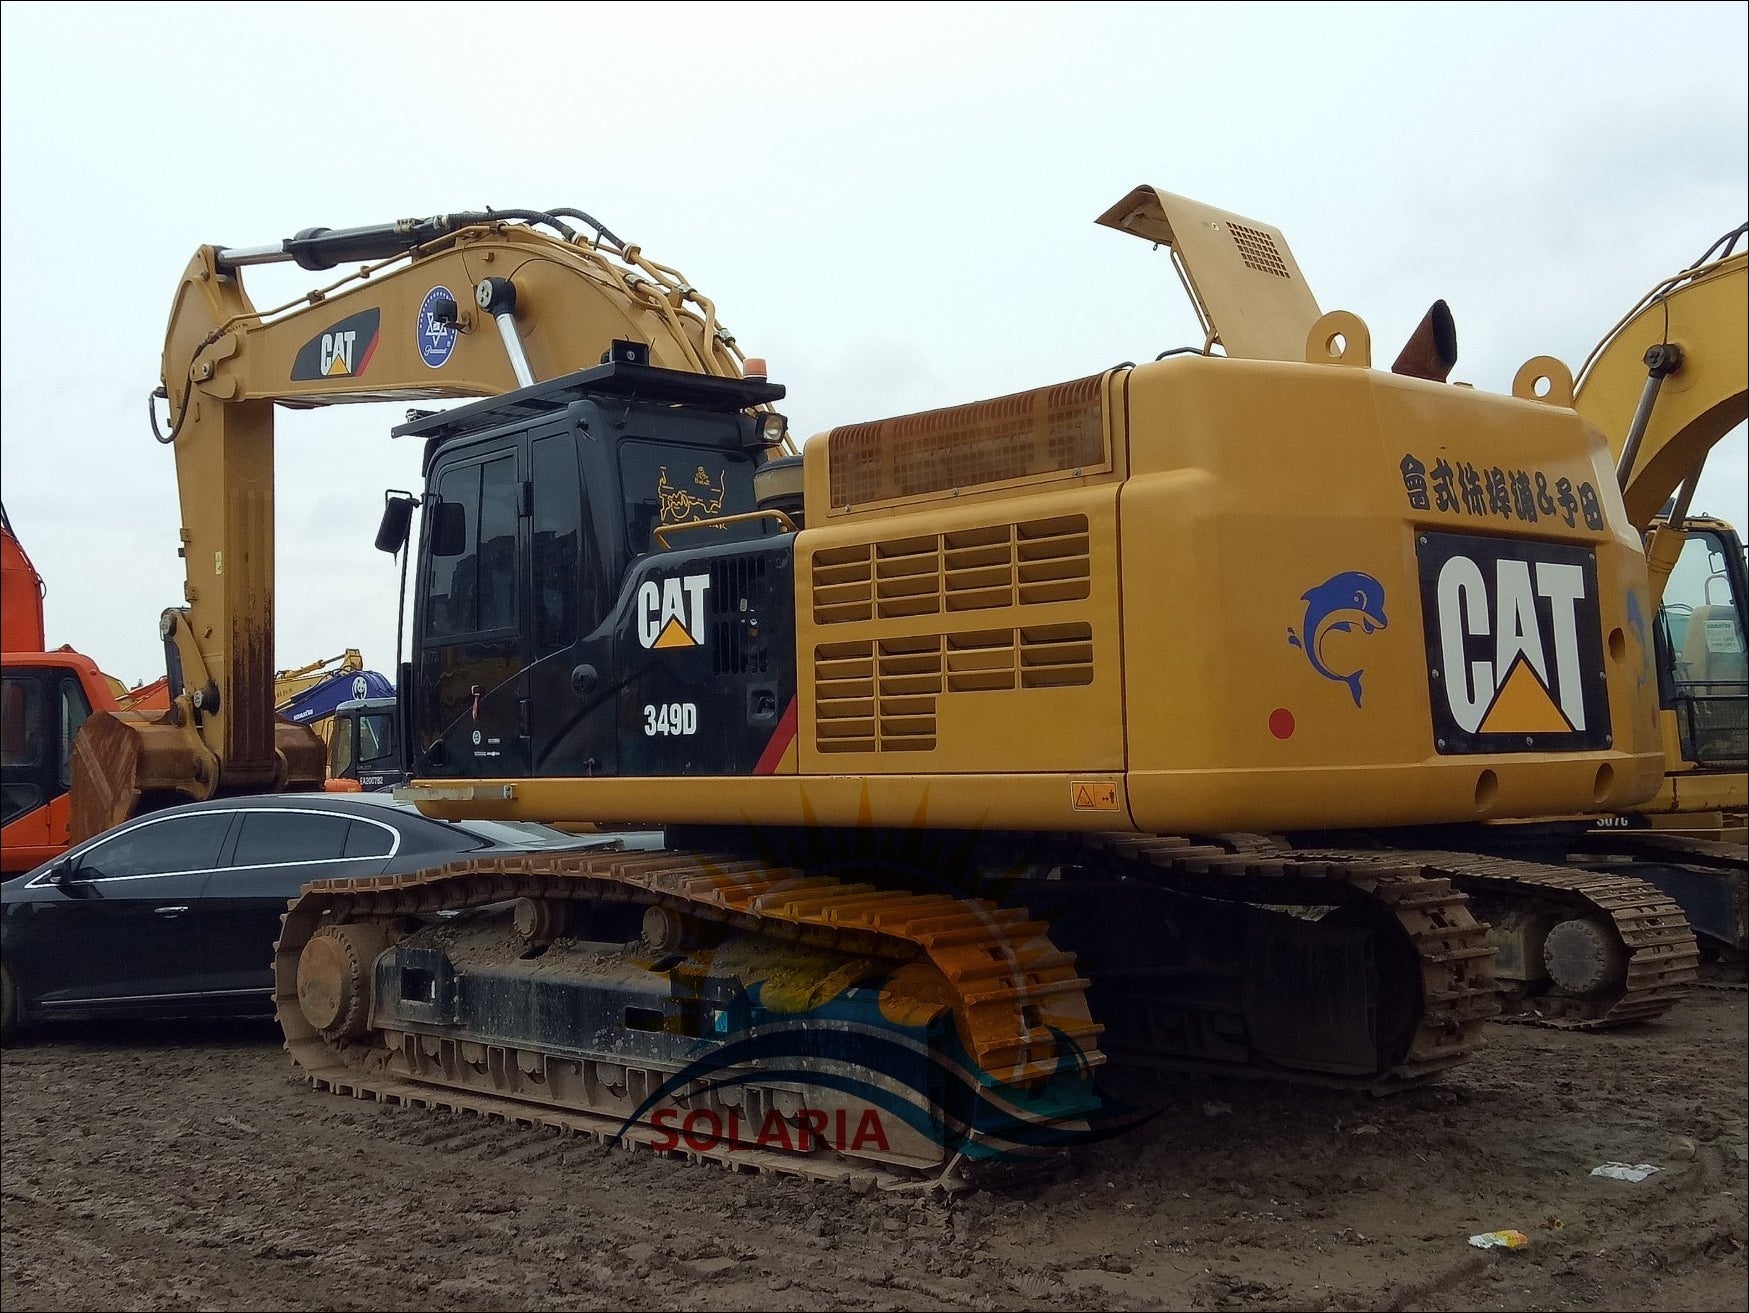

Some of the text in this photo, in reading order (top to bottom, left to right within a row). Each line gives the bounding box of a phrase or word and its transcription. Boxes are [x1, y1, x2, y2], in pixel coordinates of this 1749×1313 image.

[320, 330, 356, 376] CAT
[637, 574, 710, 649] CAT
[1437, 555, 1586, 734] CAT
[643, 703, 697, 736] 349D
